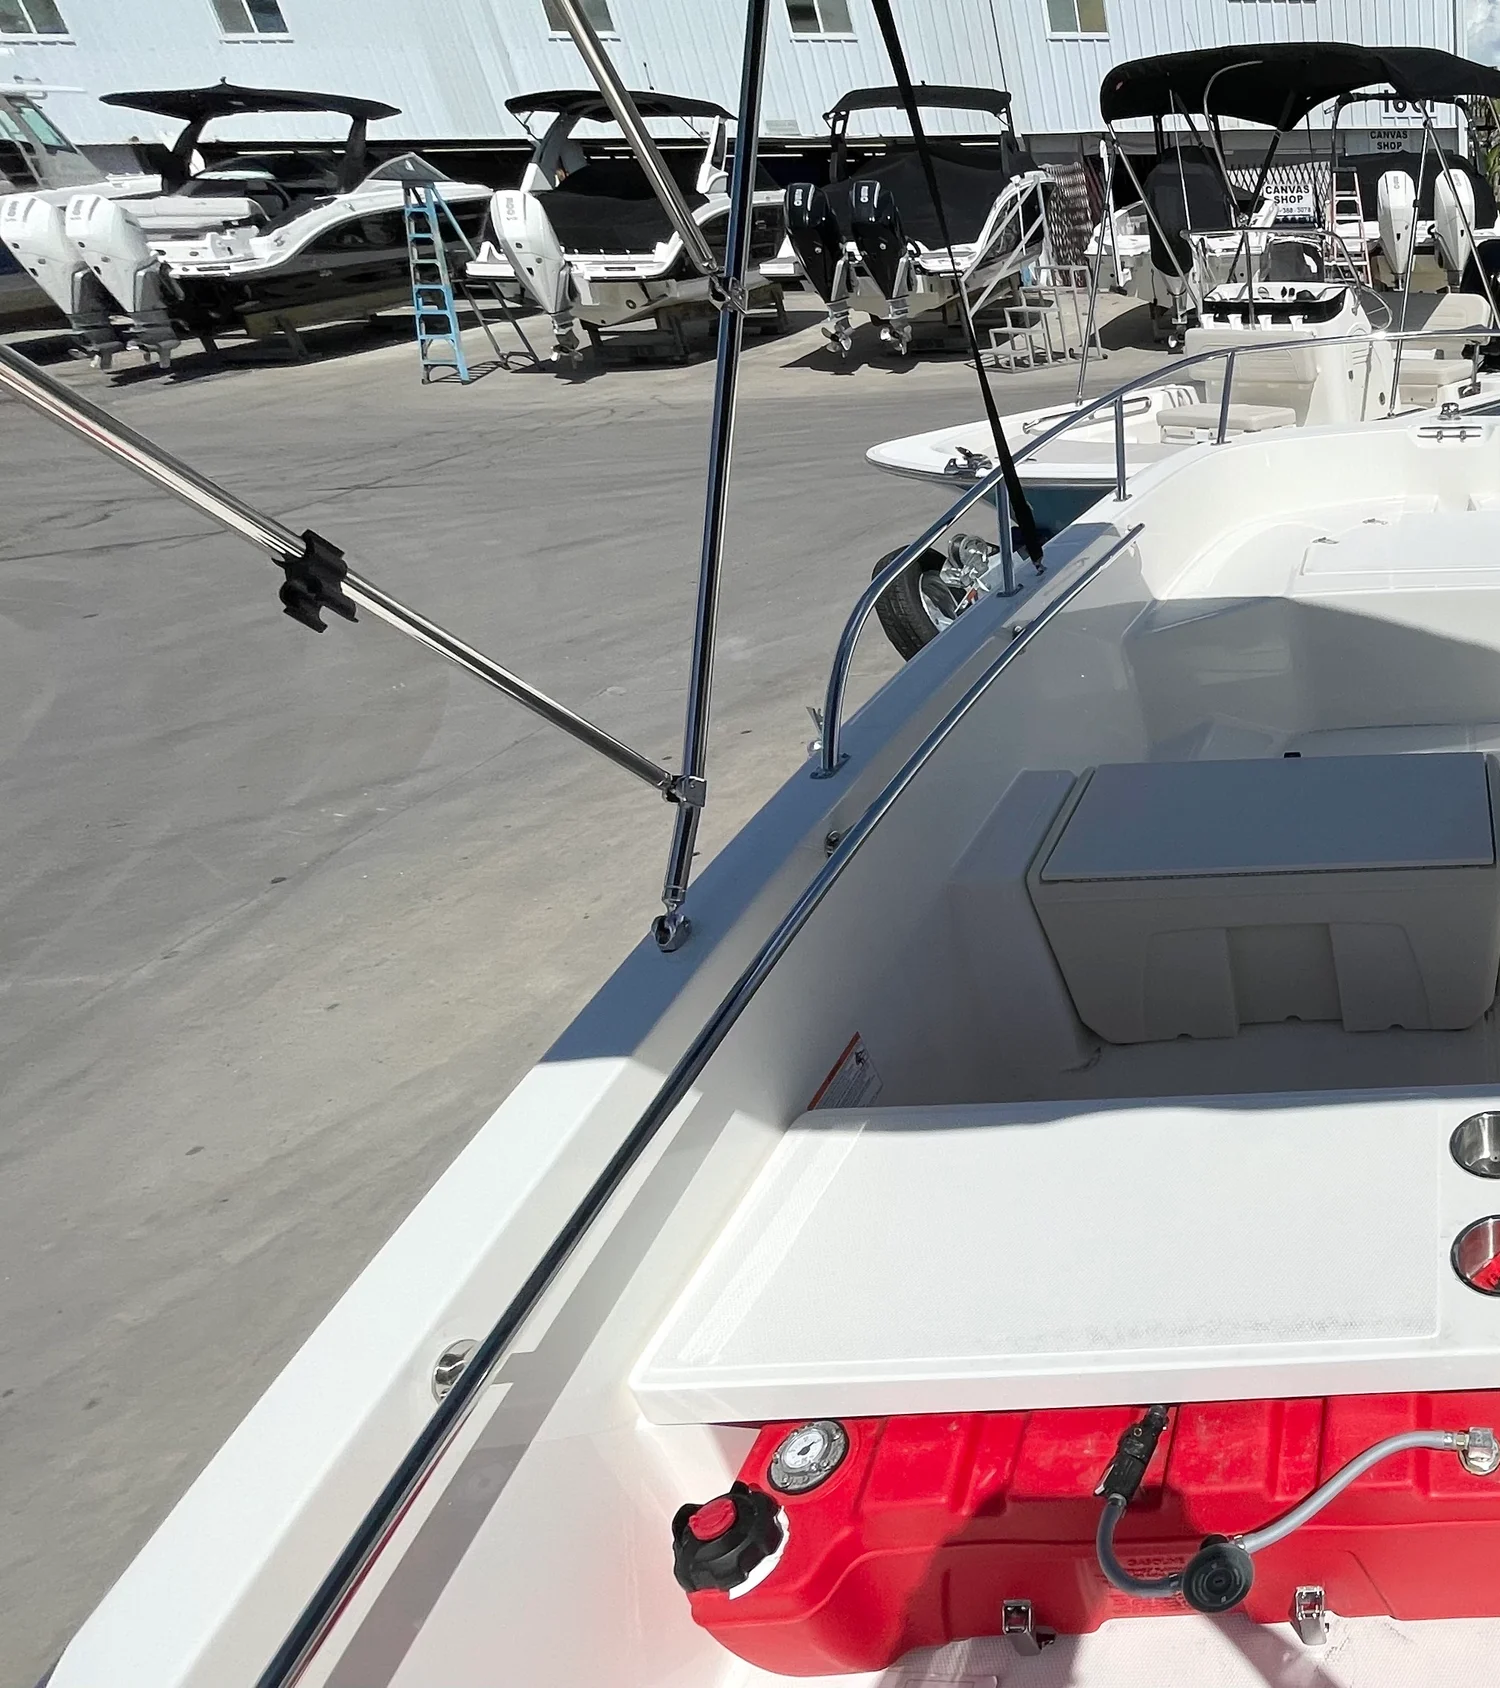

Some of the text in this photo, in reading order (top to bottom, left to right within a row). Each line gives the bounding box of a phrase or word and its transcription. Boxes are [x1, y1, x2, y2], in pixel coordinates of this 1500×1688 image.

[1370, 131, 1408, 139] CANVAS
[1377, 142, 1402, 150] SHOP
[1265, 185, 1310, 194] CANVAS
[1273, 195, 1304, 205] SHOP
